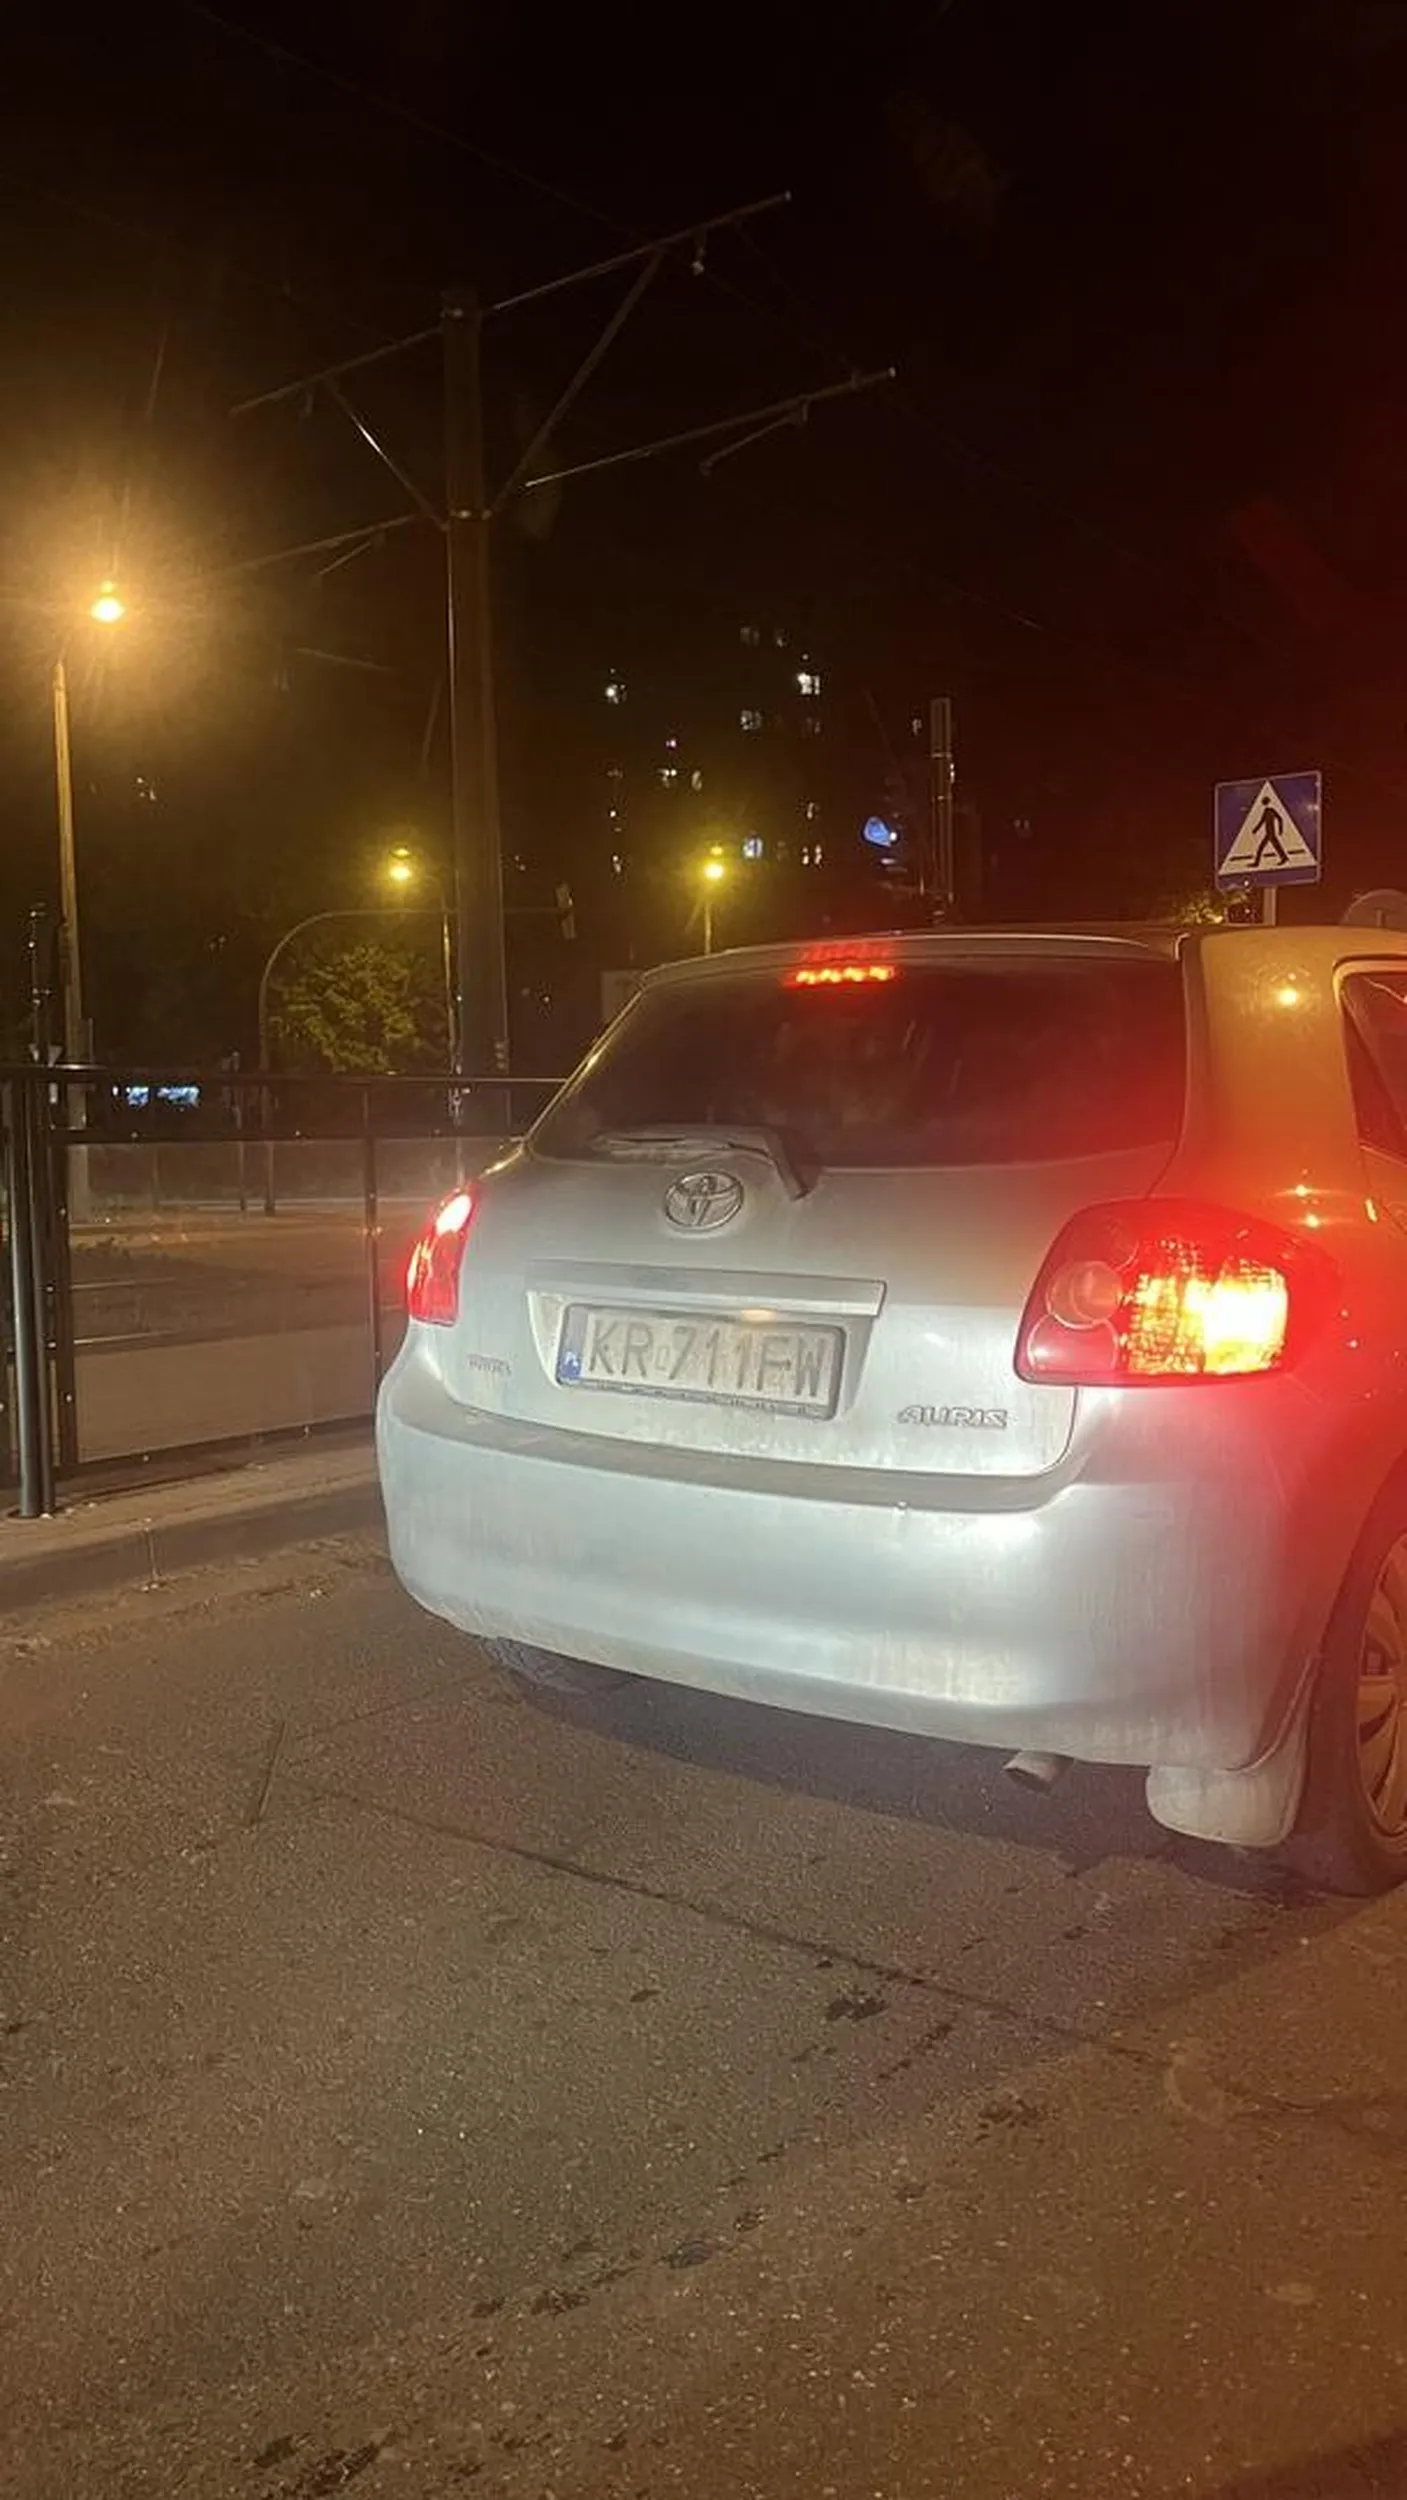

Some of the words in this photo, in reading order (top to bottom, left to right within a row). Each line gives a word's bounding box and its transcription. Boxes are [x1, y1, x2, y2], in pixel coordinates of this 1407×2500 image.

[588, 1317, 653, 1379] KR
[670, 1326, 825, 1397] 711FW
[897, 1404, 1008, 1430] AURIS
